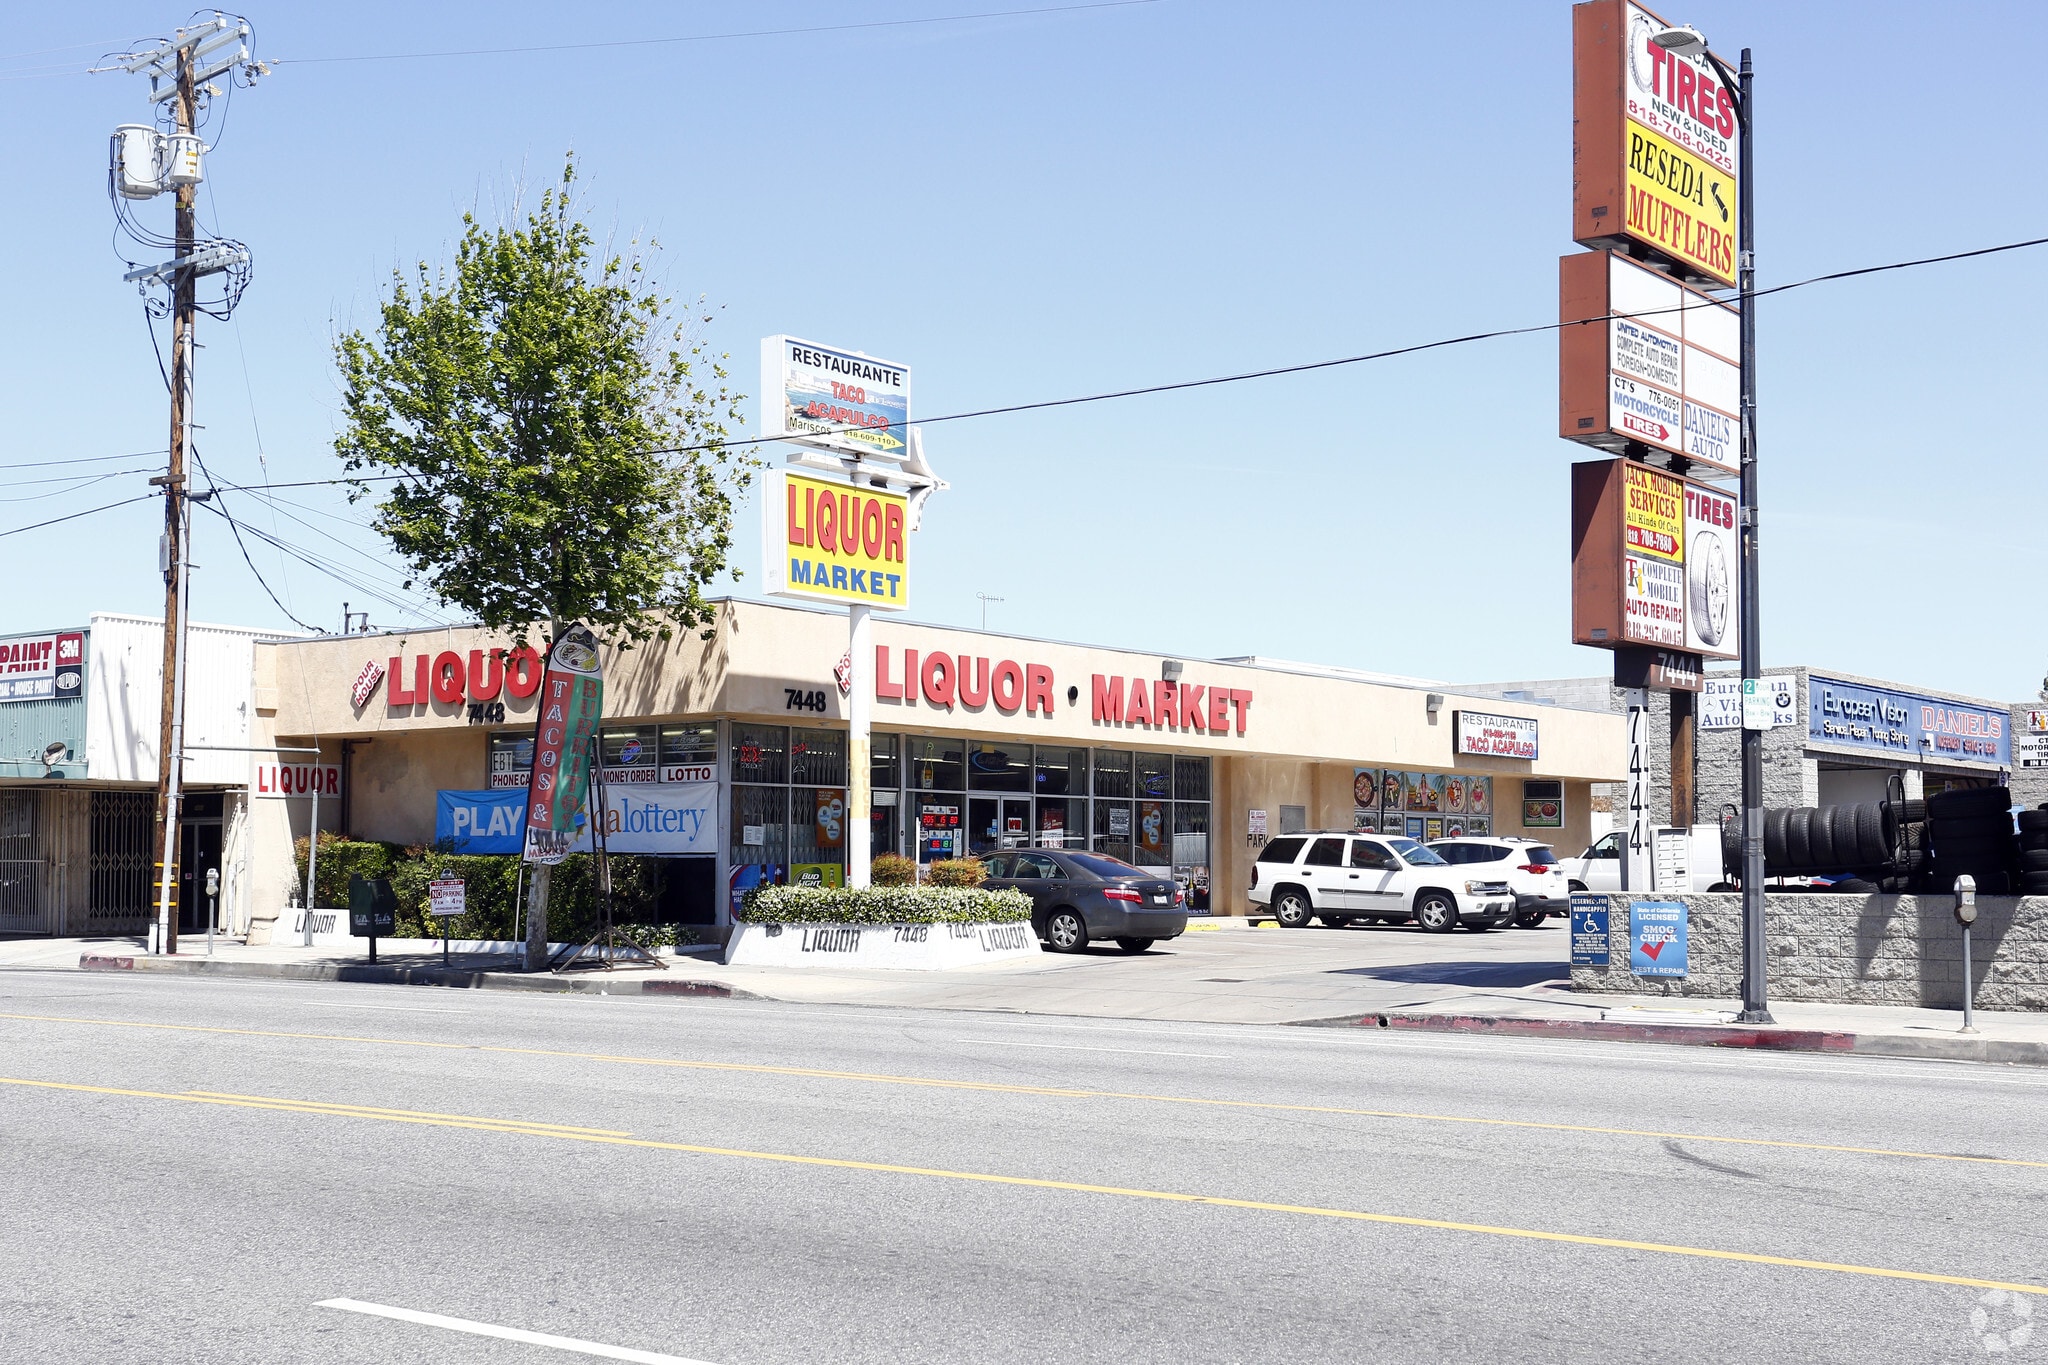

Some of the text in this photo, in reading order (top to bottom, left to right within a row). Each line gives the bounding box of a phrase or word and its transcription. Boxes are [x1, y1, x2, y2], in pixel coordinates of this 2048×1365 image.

[1647, 38, 1734, 139] TIRES
[1628, 99, 1733, 170] 818-708-0425
[1651, 98, 1728, 153] NEW & USED
[1629, 132, 1705, 207] RESEDA
[1627, 184, 1733, 275] MUFFLERS
[1617, 320, 1679, 354] UNITED AUTOMOTIVE
[1617, 334, 1644, 358] COMPLETE
[1646, 346, 1660, 363] AUTO
[792, 346, 901, 387] RESTAURANTE
[830, 381, 866, 404] TACO
[1614, 377, 1680, 412] CT'S 776-0051
[807, 400, 890, 431] ACAPULCO
[1613, 391, 1680, 427] MOTORCYCLE
[789, 417, 832, 436] Mariscos
[1624, 414, 1662, 438] TIRES
[1684, 402, 1731, 446] DANIEL'S
[1691, 435, 1724, 462] AUTO
[1625, 465, 1681, 499] JACK MOBILE
[1629, 487, 1677, 520] SERVICES
[1685, 490, 1734, 530] TIRES
[788, 484, 904, 563] LIQUOR
[1626, 511, 1637, 522] All
[1638, 513, 1657, 528] Kinds
[1666, 521, 1680, 535] Cars
[1627, 528, 1639, 544] 818
[791, 558, 901, 598] MARKET
[1642, 562, 1682, 584] COMPLETE
[1646, 581, 1679, 603] MOBILE
[1626, 598, 1683, 624] AUTO REPAIRS
[0, 641, 53, 674] PAINT
[60, 640, 79, 658] 3M
[352, 660, 375, 693] POUR
[388, 643, 552, 706] LIQUO
[1657, 652, 1697, 687] 7444
[15, 680, 34, 695] HOUSE
[34, 679, 53, 694] PAINT
[355, 665, 382, 707] HOUSE
[875, 644, 1253, 732] LIQUOR MARKET
[1745, 681, 1753, 693] 2
[467, 703, 505, 724] 7448
[784, 688, 827, 712] 7448
[1823, 688, 1909, 724] European Vision
[537, 679, 568, 791] TACOS
[1462, 714, 1535, 731] RESTAURANTE
[1920, 706, 2002, 738] DANIEL'S
[1466, 736, 1534, 757] TACO ACAPULCO
[492, 753, 513, 771] EBT
[667, 767, 711, 782] LOTTO
[258, 766, 338, 794] LIQUOR
[492, 772, 520, 786] PHONE
[604, 769, 631, 784] MONEY
[631, 769, 656, 782] ORDER
[1628, 706, 1642, 855] 7444
[453, 805, 524, 837] PLAY
[533, 803, 548, 822] &
[801, 872, 820, 880] BUD
[432, 890, 441, 898] NO
[801, 929, 861, 953] LIQUOR
[894, 926, 928, 943] 7448
[946, 923, 977, 940] 7448
[978, 926, 1029, 952] LIQUOR
[1640, 934, 1678, 942] CHECK
[1643, 926, 1675, 934] SMOG
